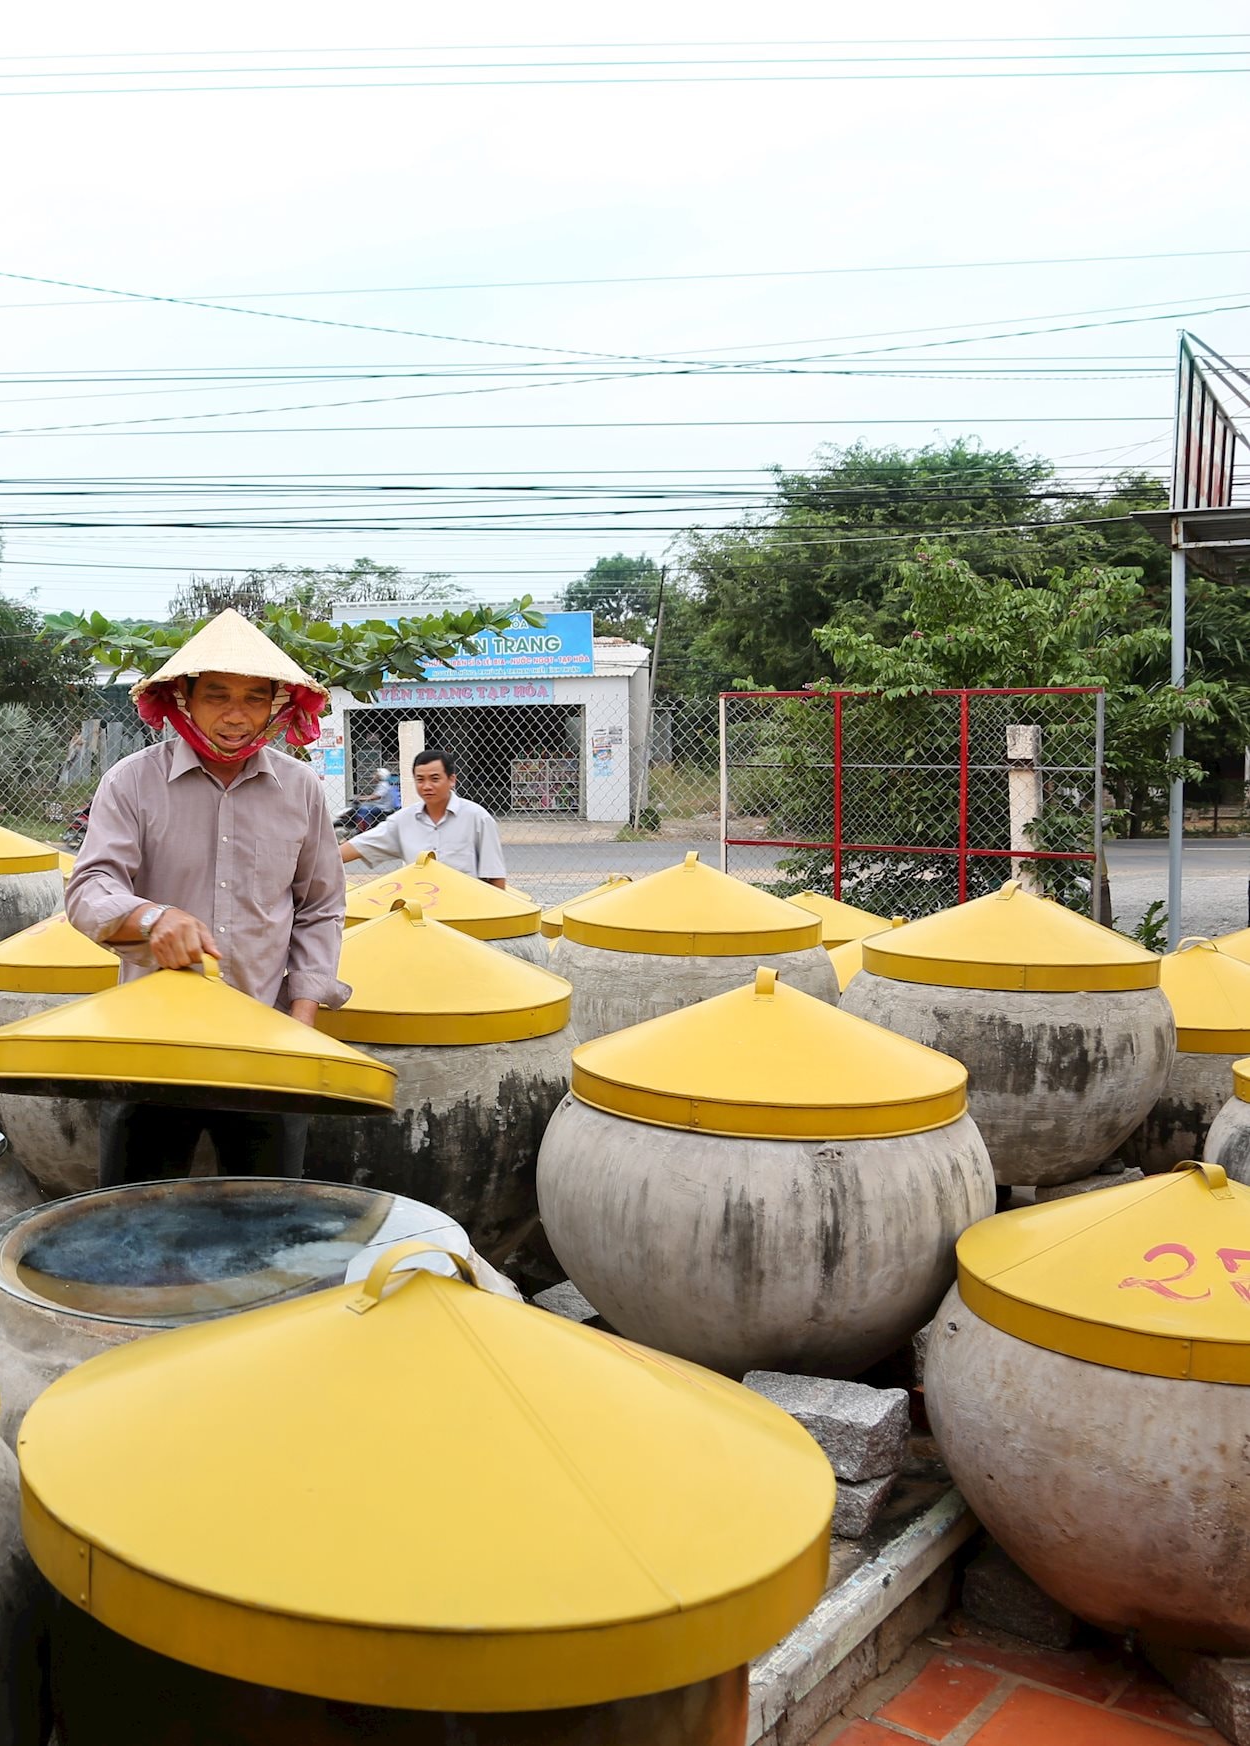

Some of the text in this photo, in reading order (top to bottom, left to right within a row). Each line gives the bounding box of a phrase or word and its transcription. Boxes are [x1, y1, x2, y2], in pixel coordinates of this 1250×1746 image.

[493, 635, 562, 655] TRANG
[510, 655, 531, 665] NƯỚC
[533, 656, 554, 666] NGỌT
[476, 685, 510, 702] TẠP
